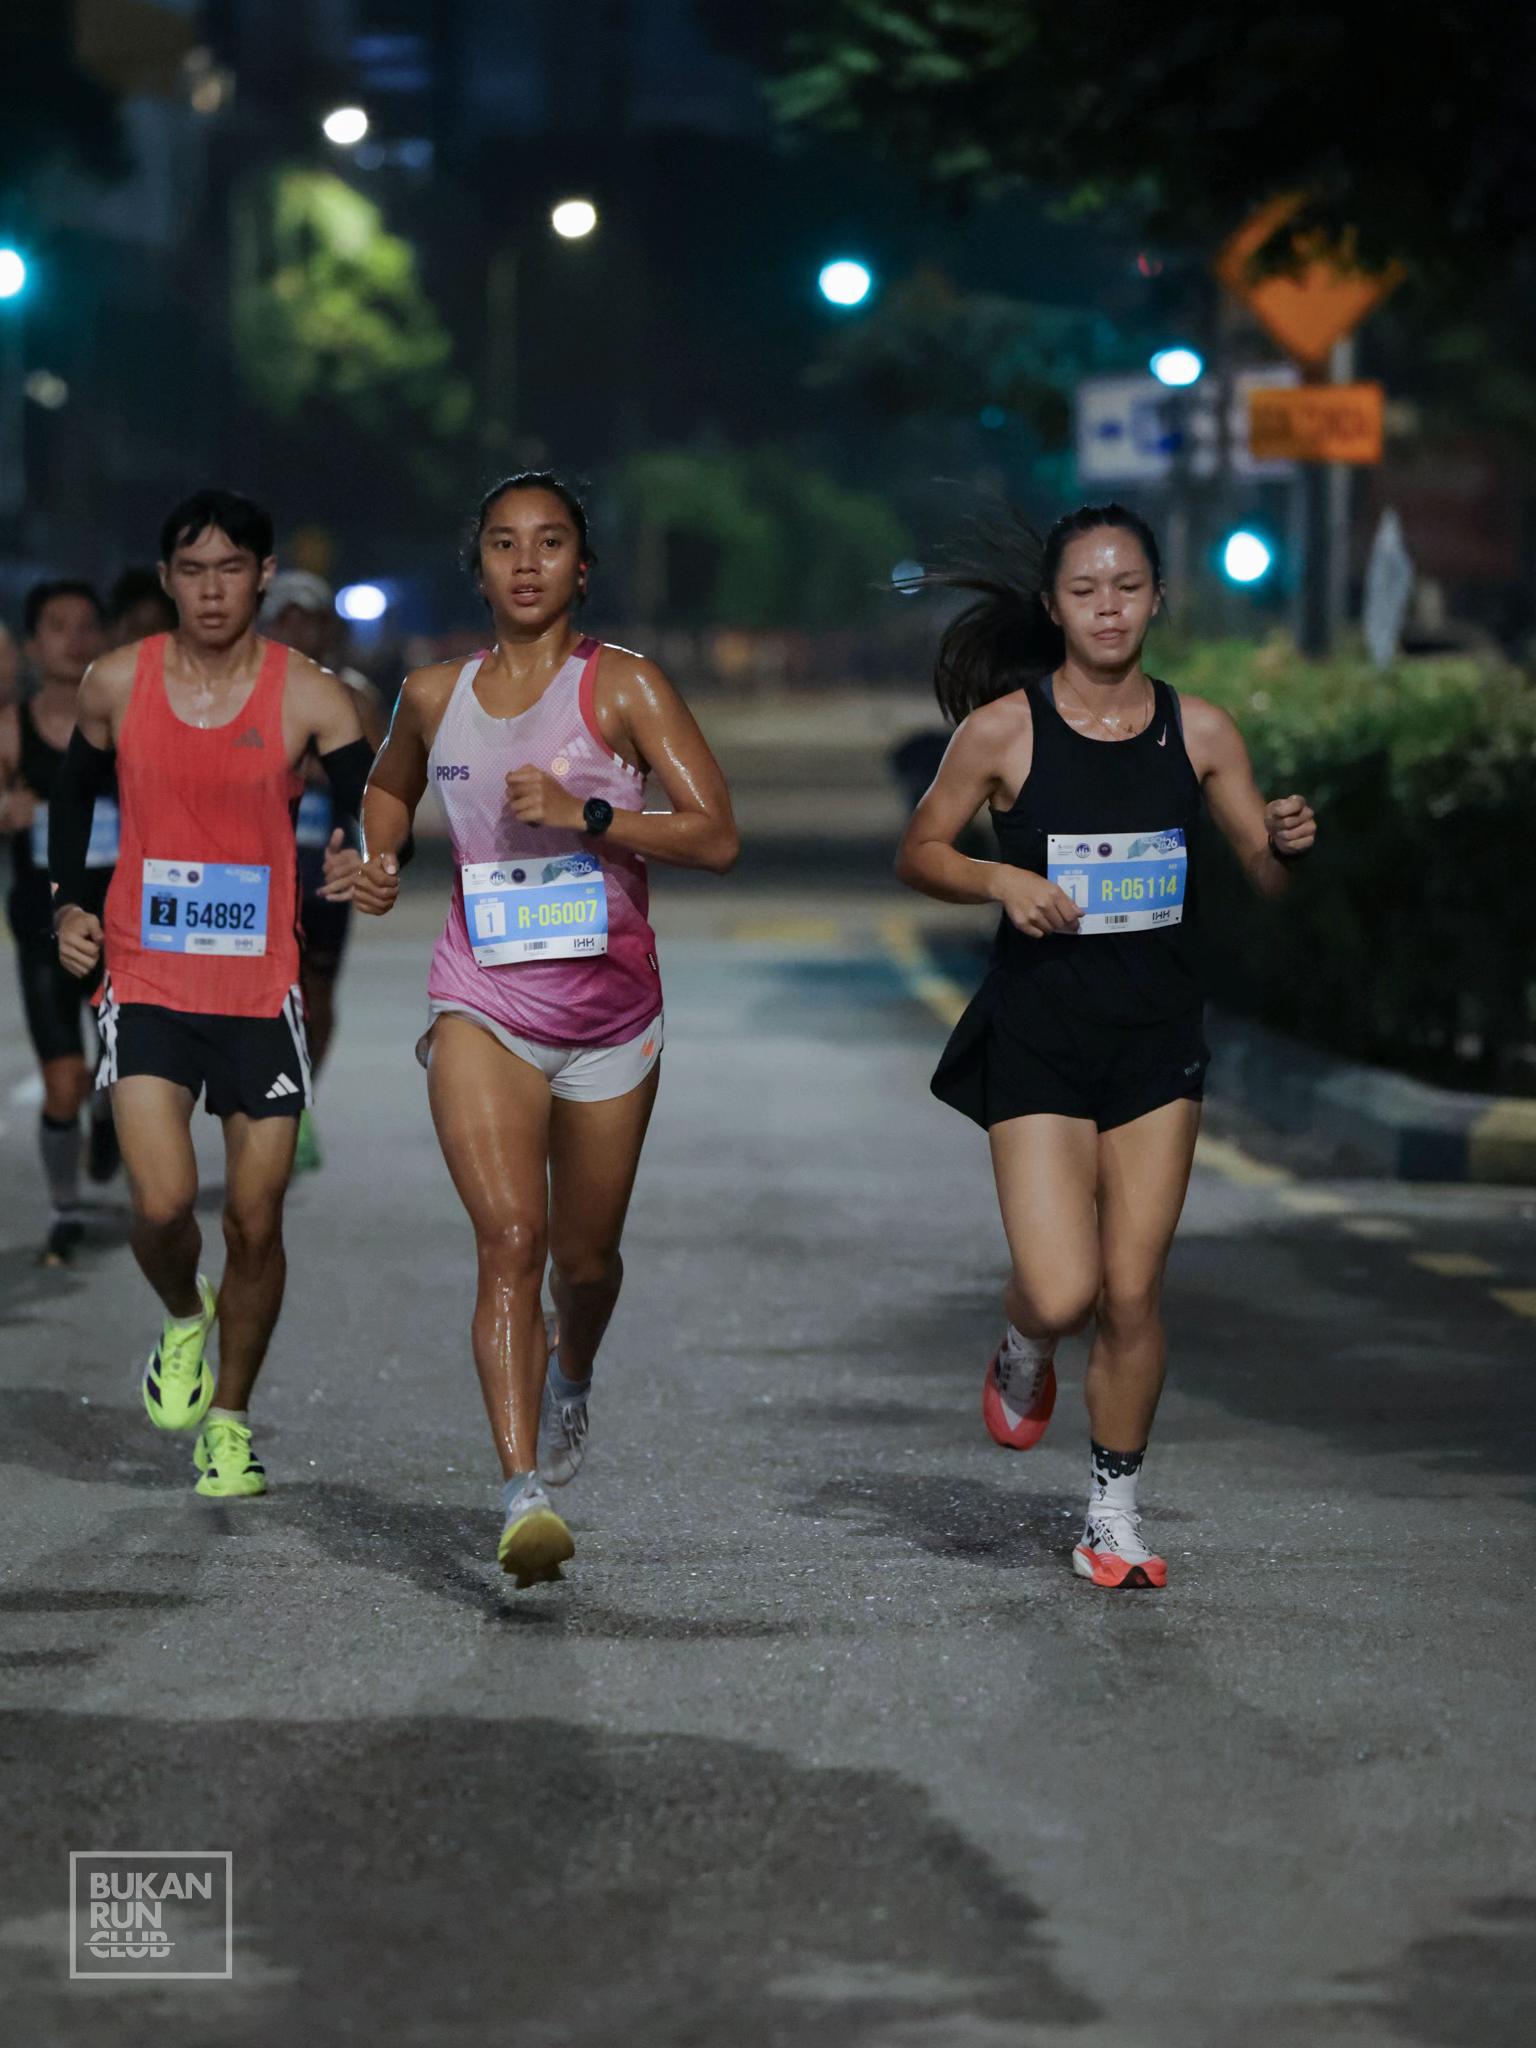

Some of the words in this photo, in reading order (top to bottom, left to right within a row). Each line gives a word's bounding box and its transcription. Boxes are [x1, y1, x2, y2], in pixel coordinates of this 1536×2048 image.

[436, 765, 470, 781] PRPS
[1101, 875, 1177, 901] R-05114
[159, 902, 169, 924] 2
[185, 901, 256, 930] 54892
[486, 912, 494, 933] 1
[517, 899, 598, 929] R-05007
